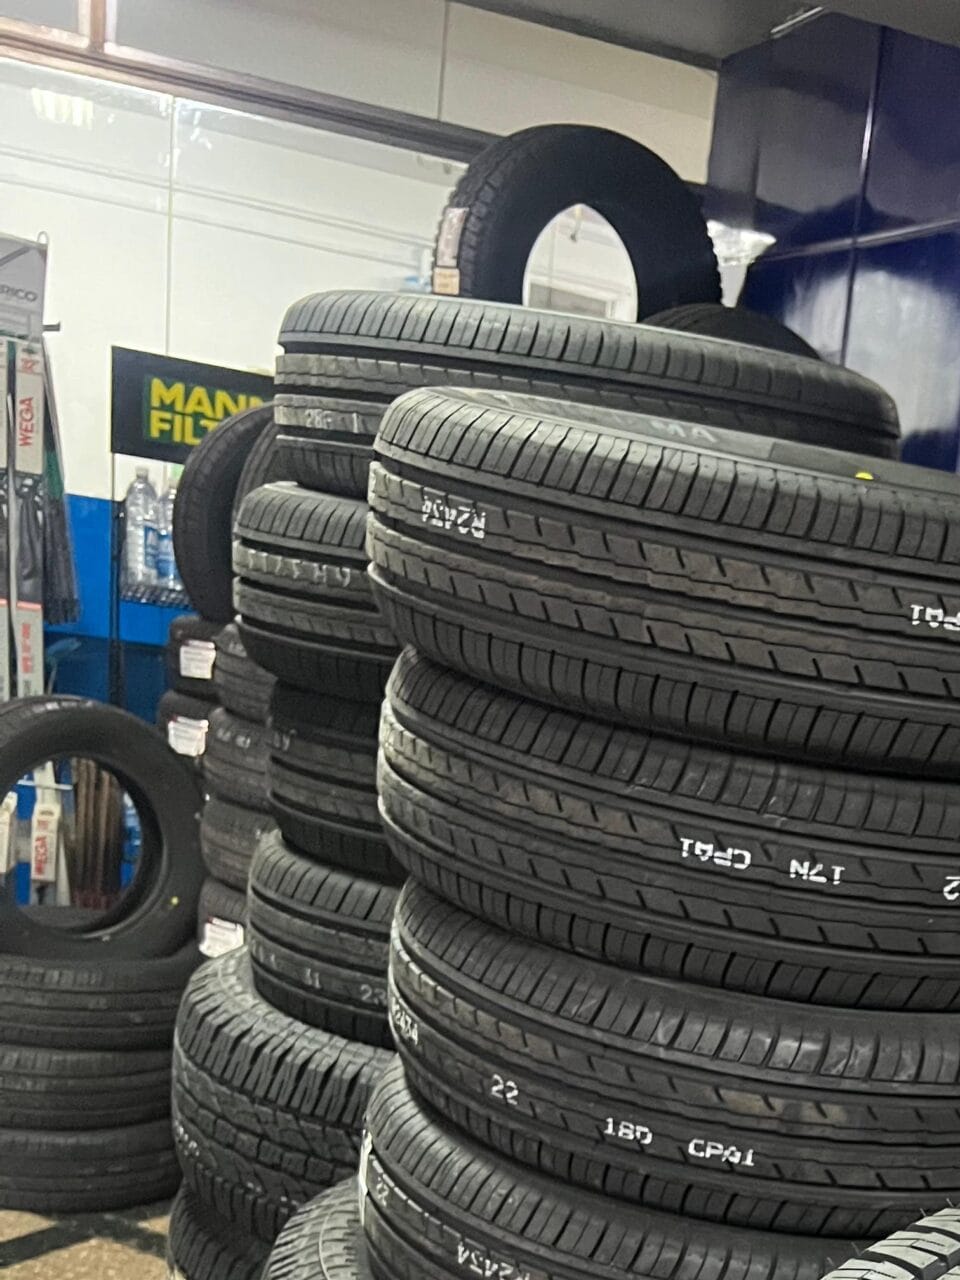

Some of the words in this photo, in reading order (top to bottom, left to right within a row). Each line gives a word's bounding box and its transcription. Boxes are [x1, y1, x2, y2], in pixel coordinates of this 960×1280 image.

[151, 377, 265, 417] MAN
[18, 397, 34, 447] WEGA
[789, 859, 845, 885] 17N
[491, 1073, 518, 1105] 22
